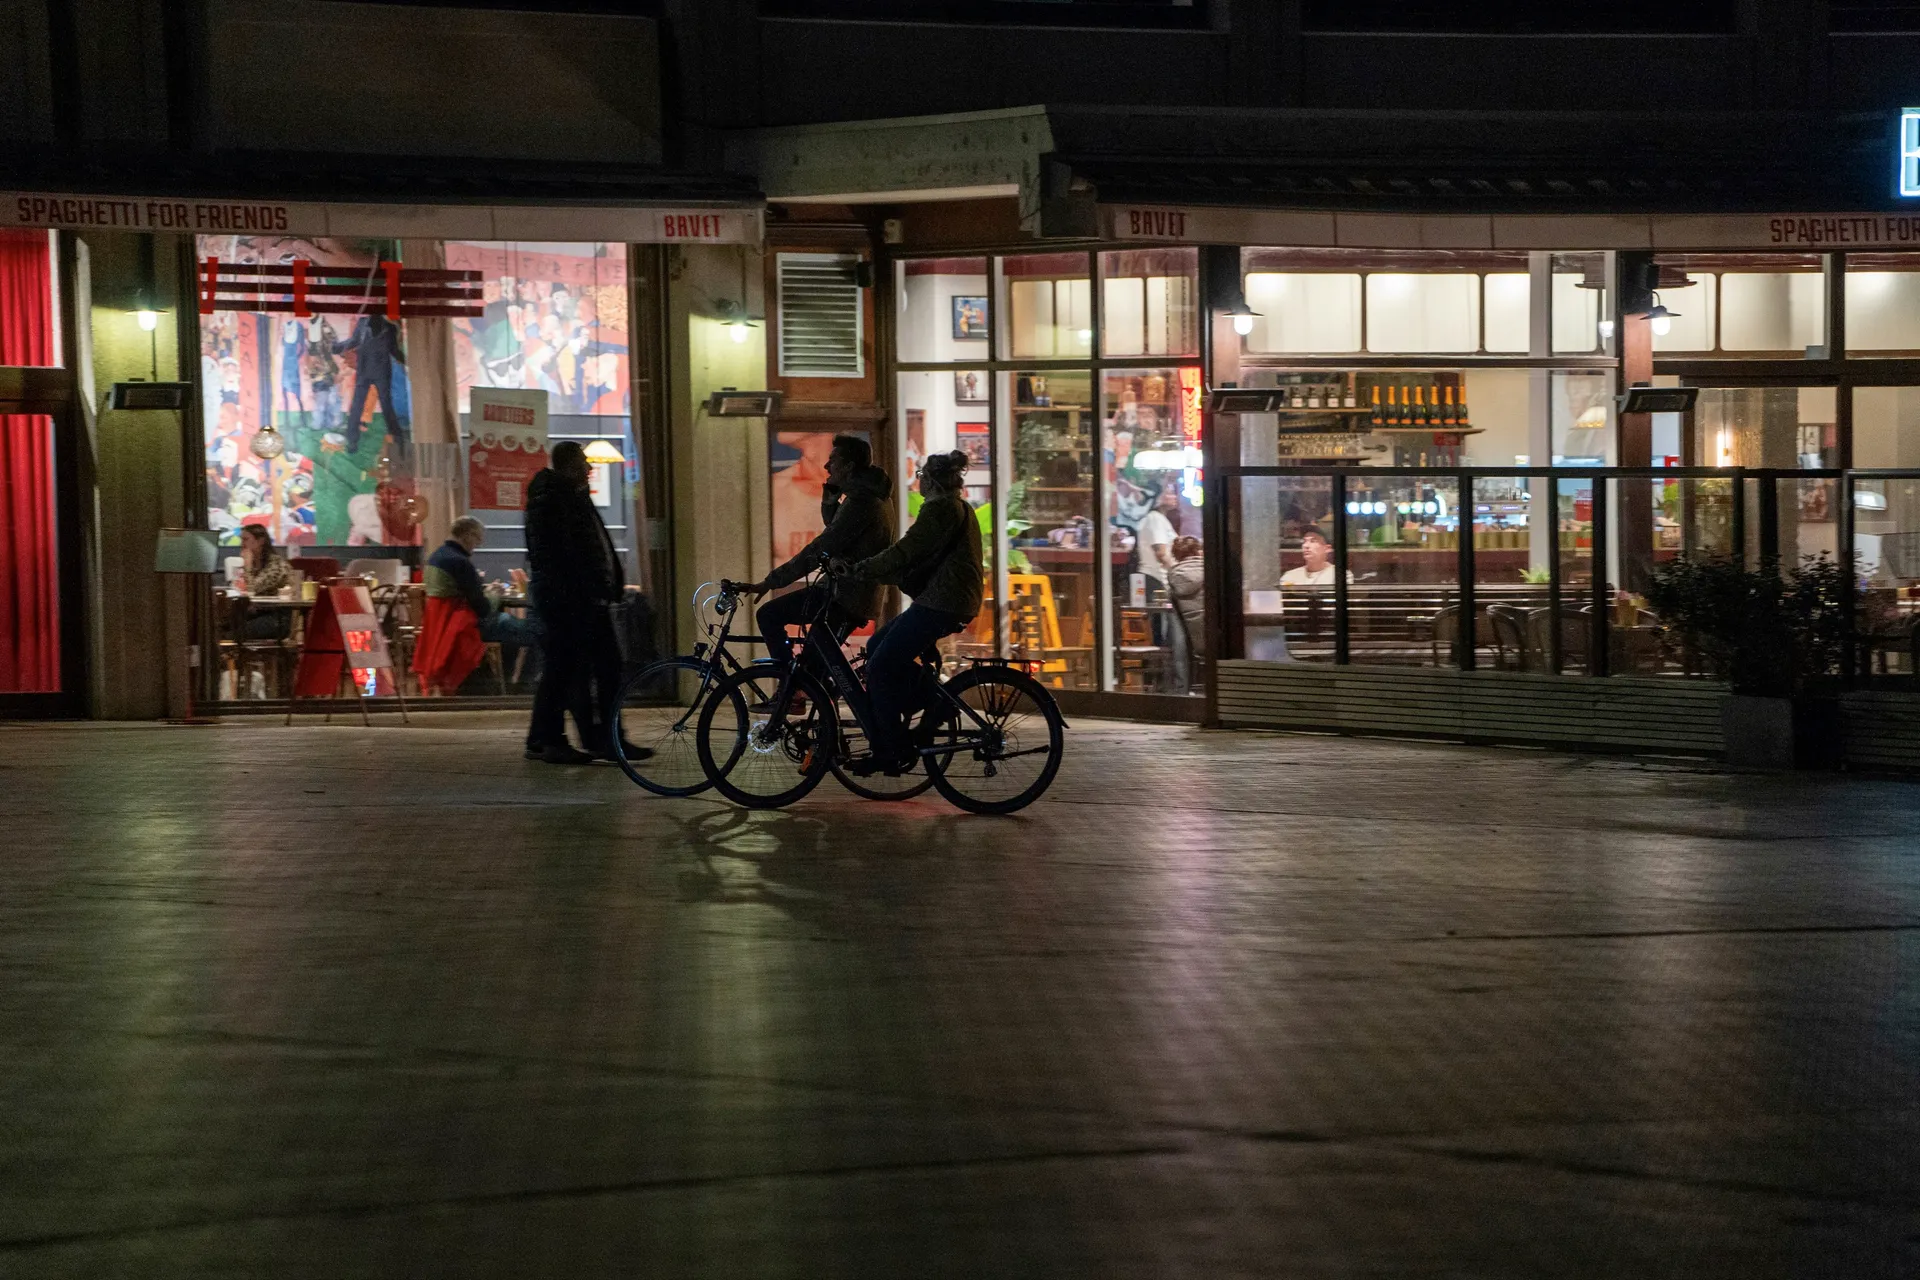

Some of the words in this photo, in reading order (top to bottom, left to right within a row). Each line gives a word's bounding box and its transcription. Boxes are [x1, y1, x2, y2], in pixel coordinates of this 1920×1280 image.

[17, 197, 139, 226] SPAGHETTI
[150, 201, 190, 228] FOR
[198, 204, 288, 231] FRIENDS
[664, 214, 721, 237] BAVET
[1130, 210, 1186, 236] BAVET
[1770, 218, 1880, 242] SPAGHETTI
